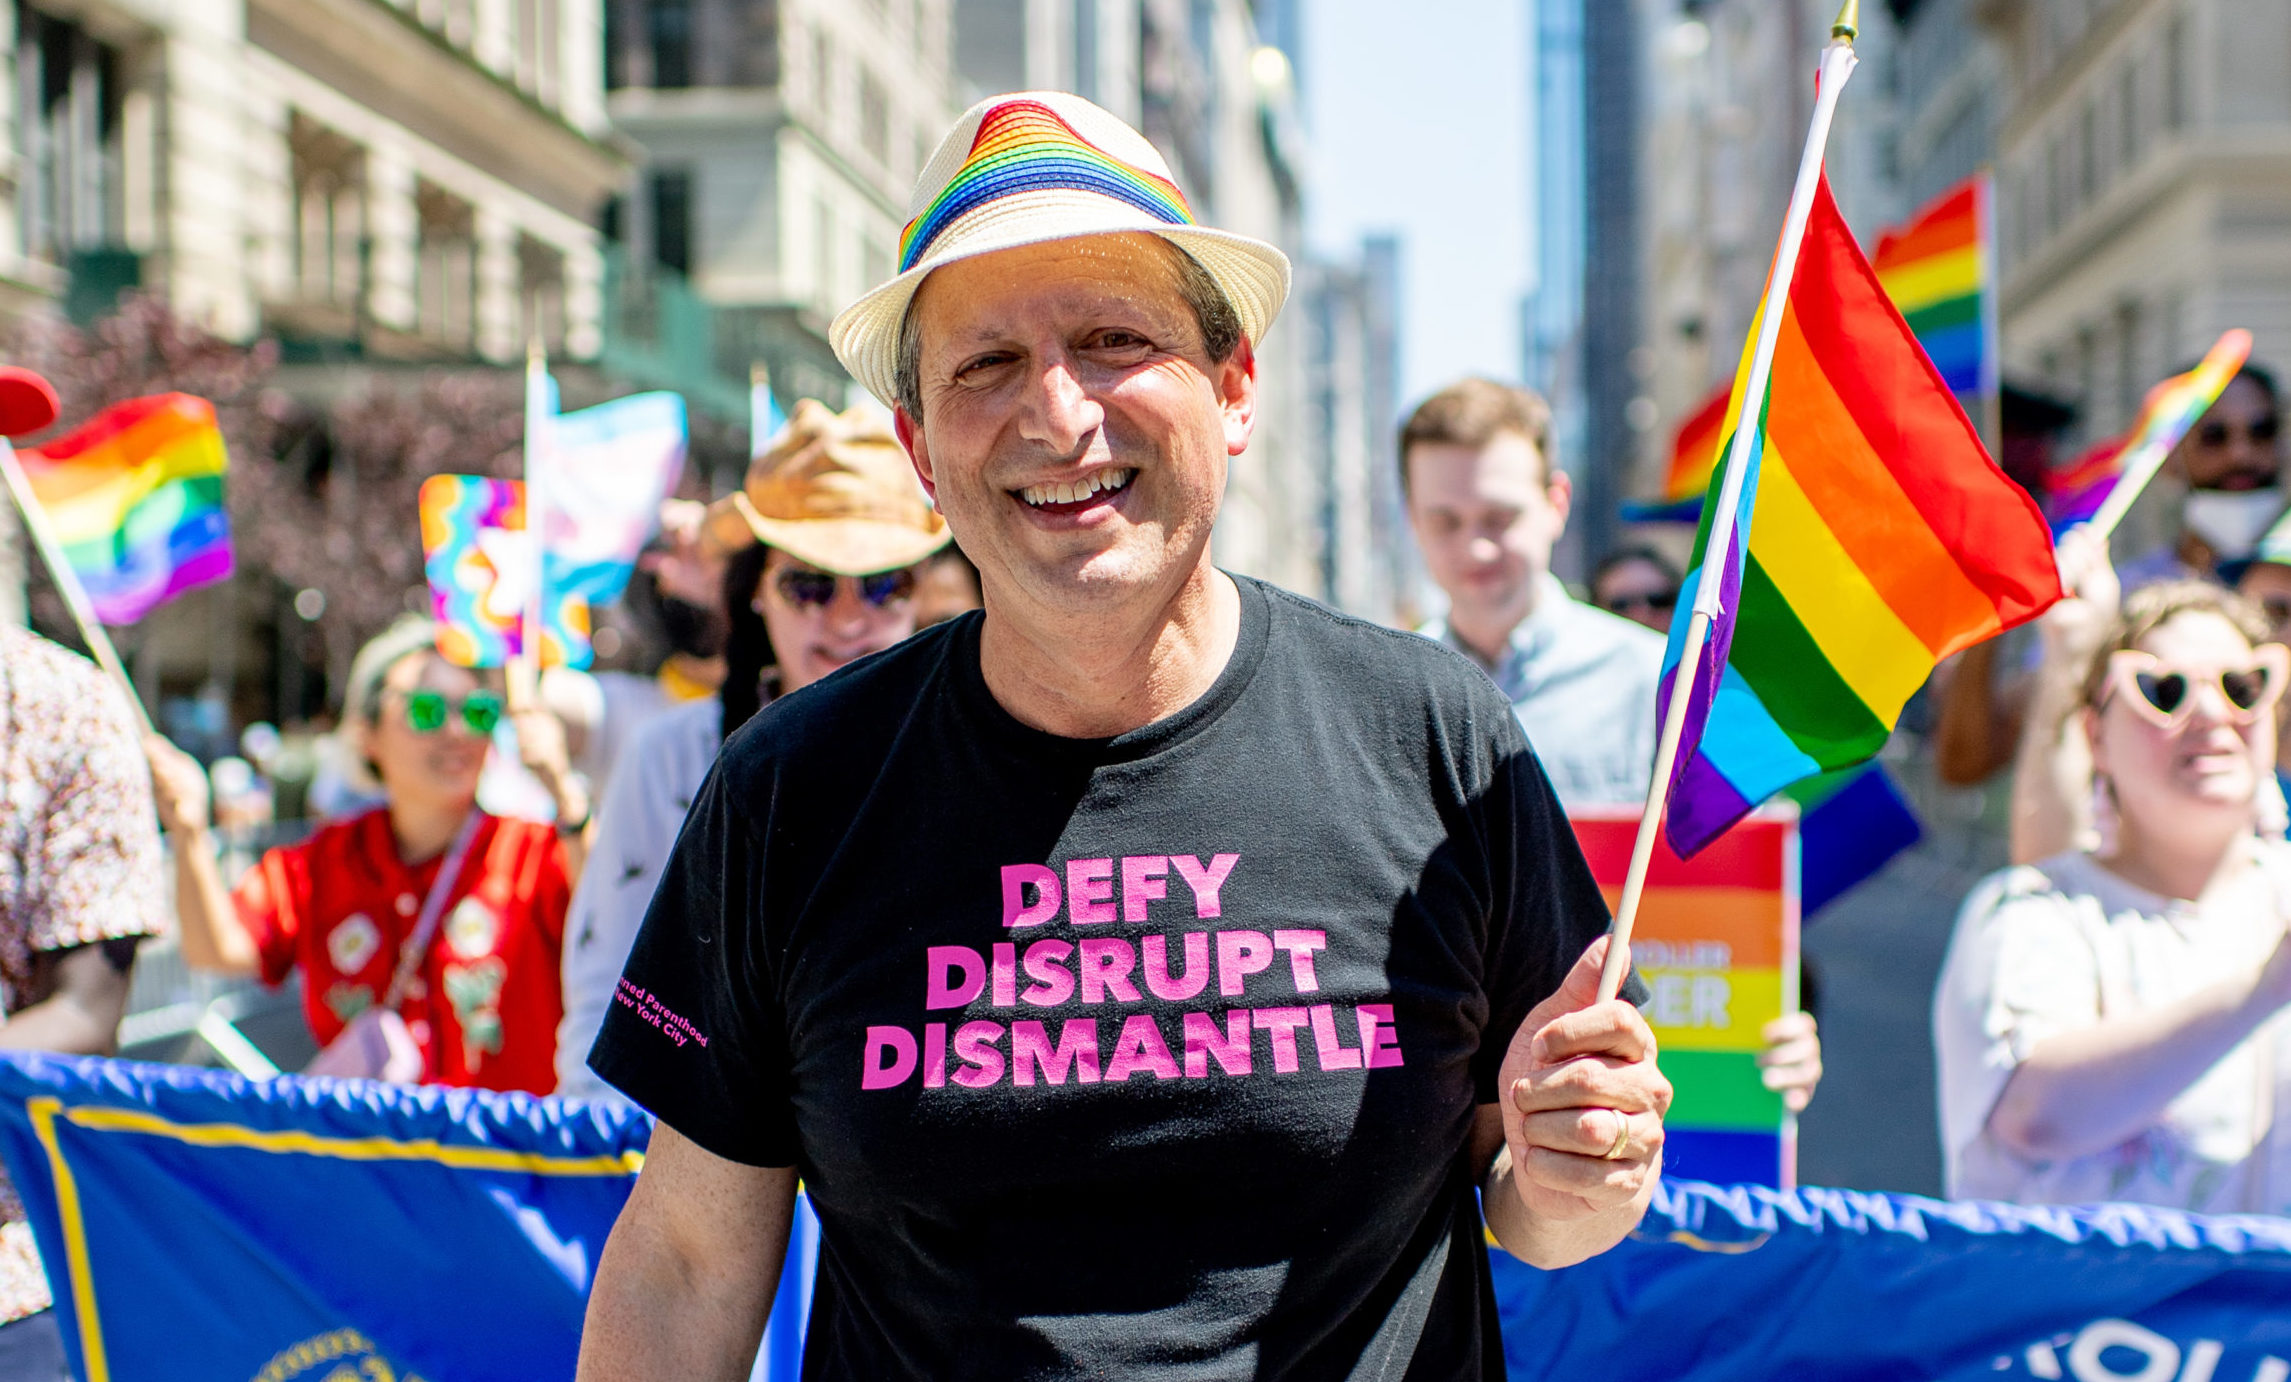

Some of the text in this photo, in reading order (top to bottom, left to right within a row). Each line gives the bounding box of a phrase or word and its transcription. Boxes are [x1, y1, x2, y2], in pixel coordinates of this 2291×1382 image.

[1000, 853, 1240, 929] DEFY
[926, 929, 1327, 1011] DISRUPT
[1640, 974, 1732, 1029] ER
[637, 1002, 662, 1028] York
[663, 1023, 688, 1047] City
[645, 993, 709, 1048] Parenthood
[861, 1004, 1405, 1091] DISMANTLE
